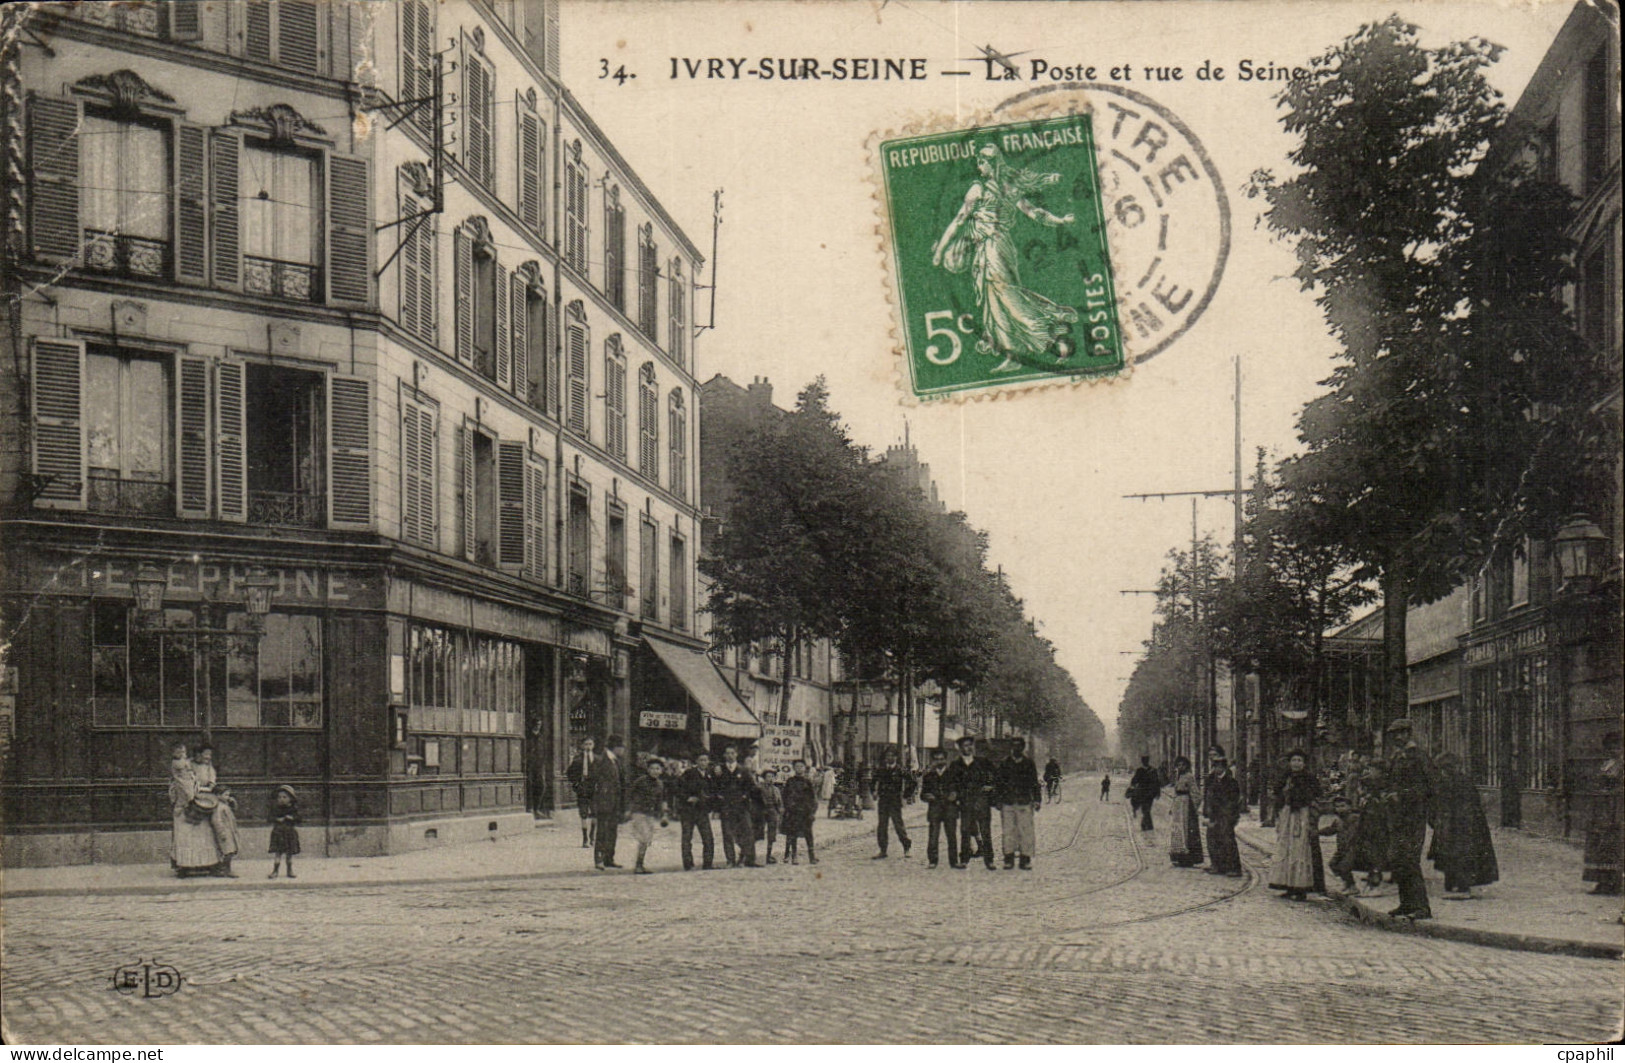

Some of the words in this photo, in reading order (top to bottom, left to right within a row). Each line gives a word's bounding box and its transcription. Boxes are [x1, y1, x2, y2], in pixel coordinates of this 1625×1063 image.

[1084, 273, 1116, 356] POSTES
[77, 559, 350, 601] TEEPHONE
[772, 737, 792, 747] 30
